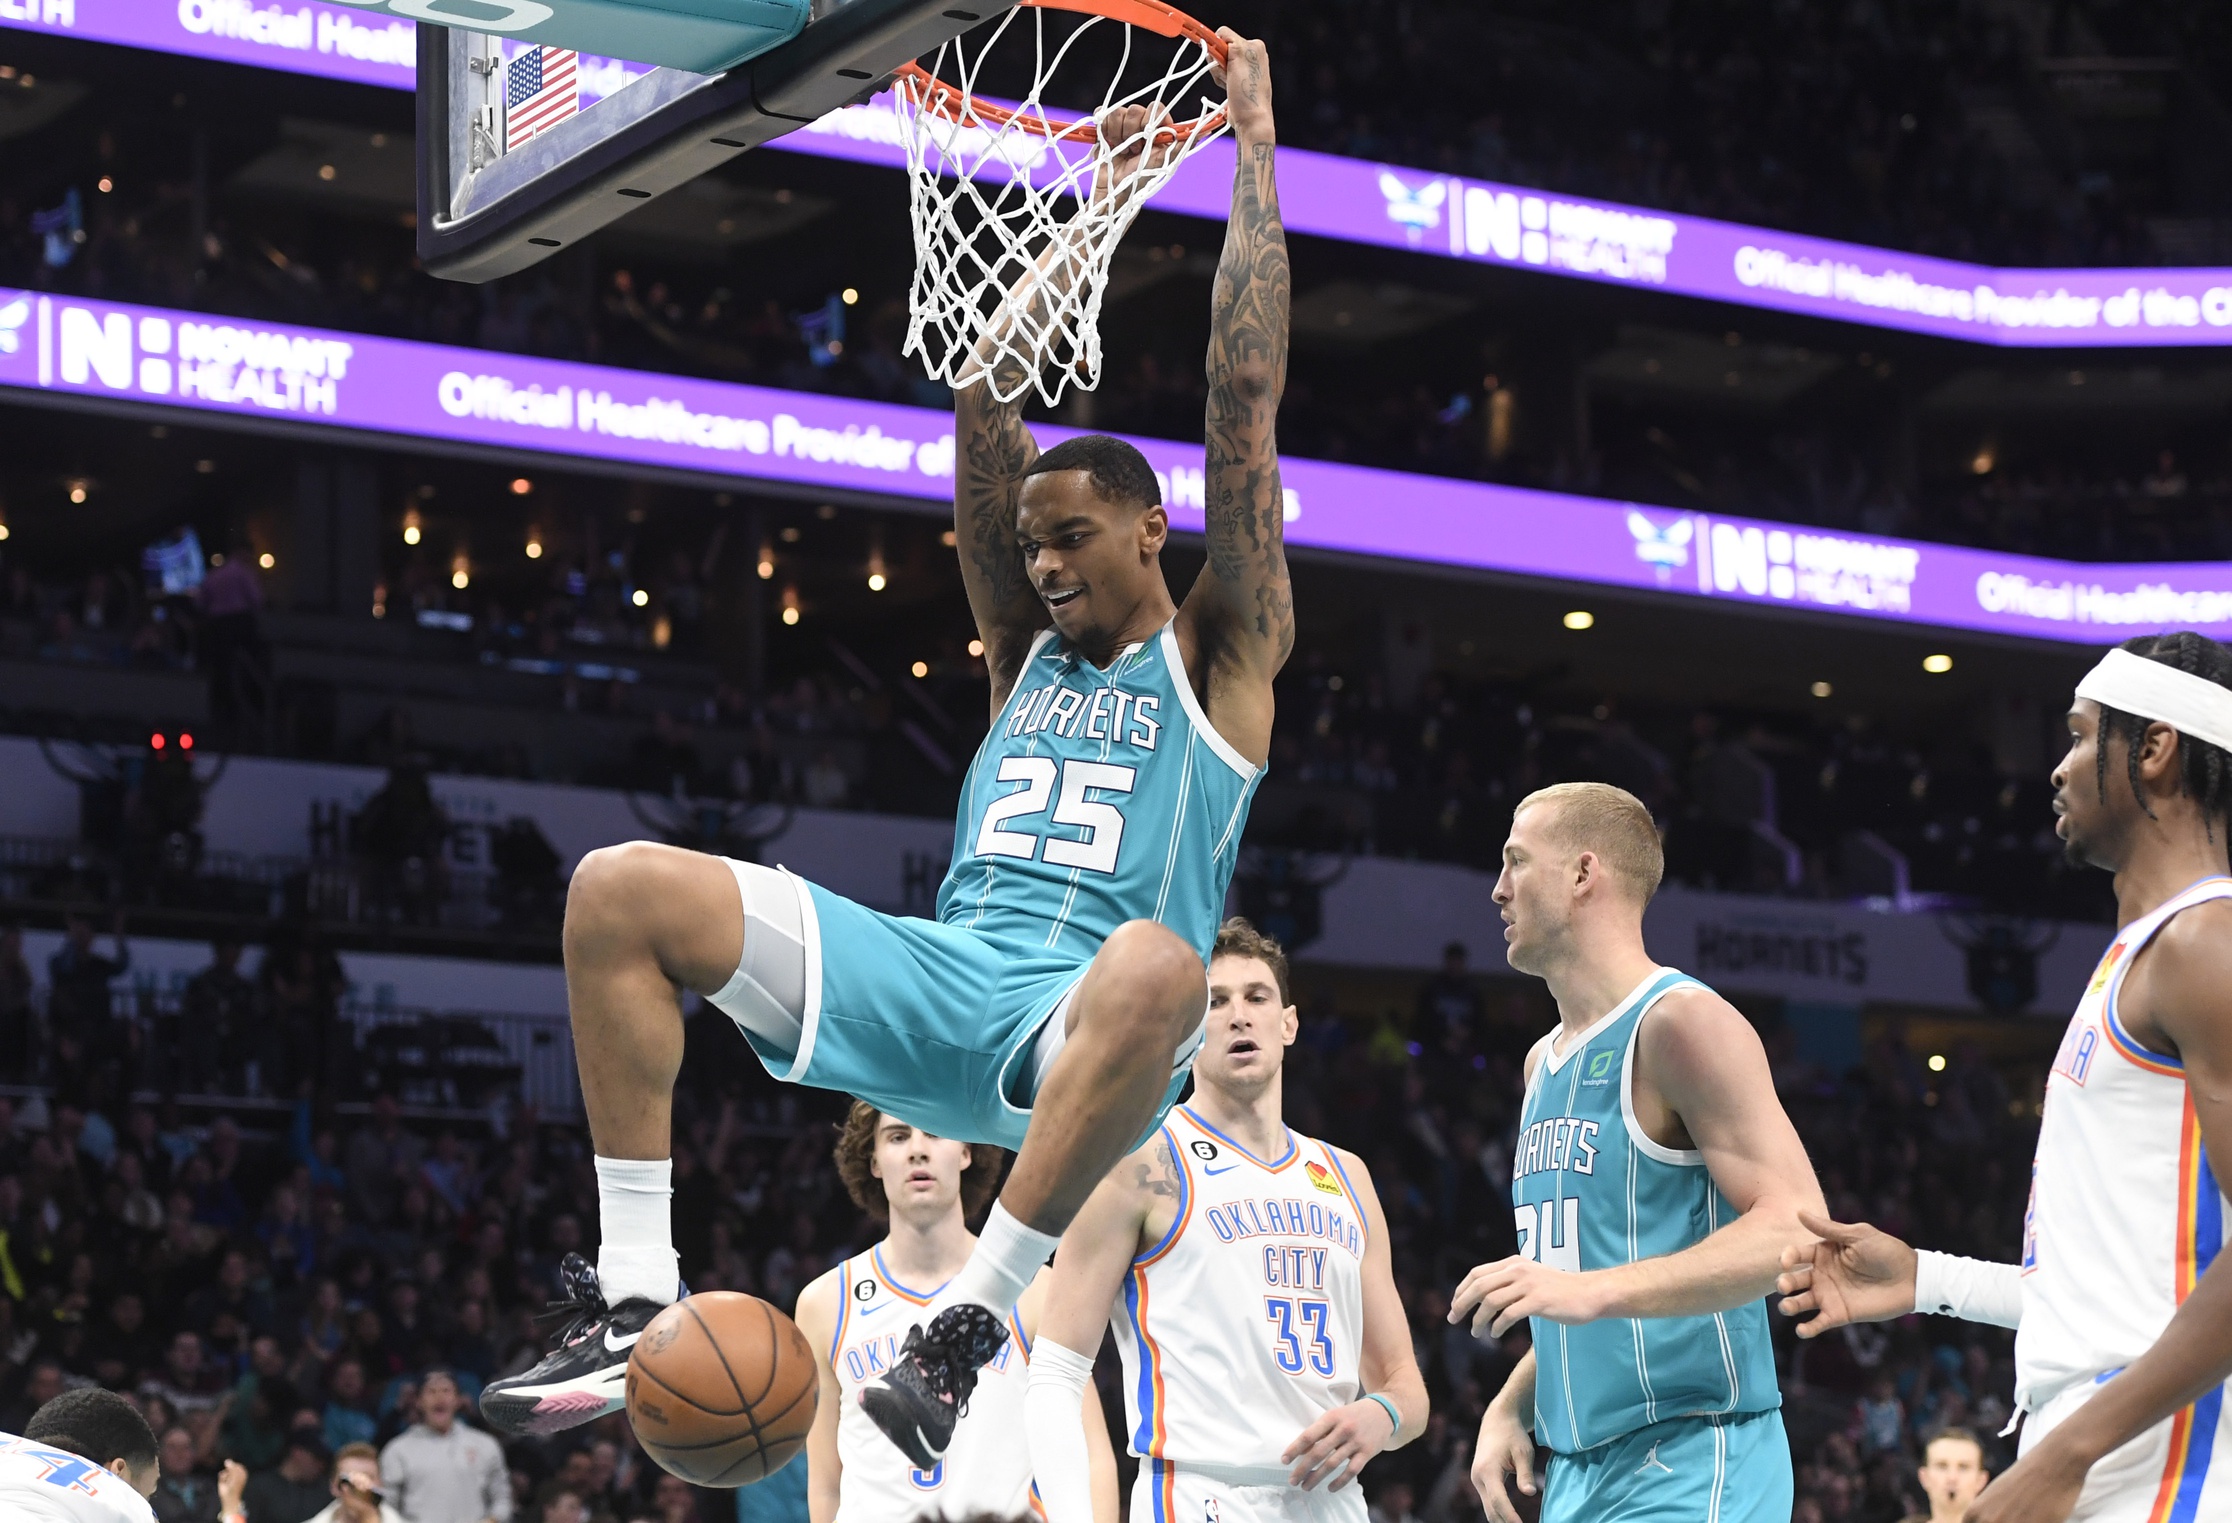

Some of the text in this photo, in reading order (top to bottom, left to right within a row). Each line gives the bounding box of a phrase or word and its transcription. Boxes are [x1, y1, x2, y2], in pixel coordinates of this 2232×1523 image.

[178, 0, 313, 50] Official
[1465, 187, 1521, 260] N
[1734, 246, 1833, 298] Official
[1834, 262, 1974, 321] Healthcare
[1974, 285, 2101, 328] Provider
[2103, 287, 2141, 328] of
[2143, 287, 2200, 328] the
[61, 307, 132, 389] N
[438, 371, 955, 478] Official Healthcare Provider of
[1711, 523, 1768, 596] N
[1976, 571, 2232, 624] Official Healthcar
[974, 756, 1137, 876] 25
[1195, 1142, 1214, 1160] 6
[1513, 1117, 1600, 1181] ORNETS
[1205, 1198, 1360, 1260] OKLAHOMA
[1515, 1197, 1582, 1273] 24
[858, 1281, 875, 1300] 6
[1262, 1244, 1328, 1290] CITY
[1264, 1296, 1337, 1380] 33
